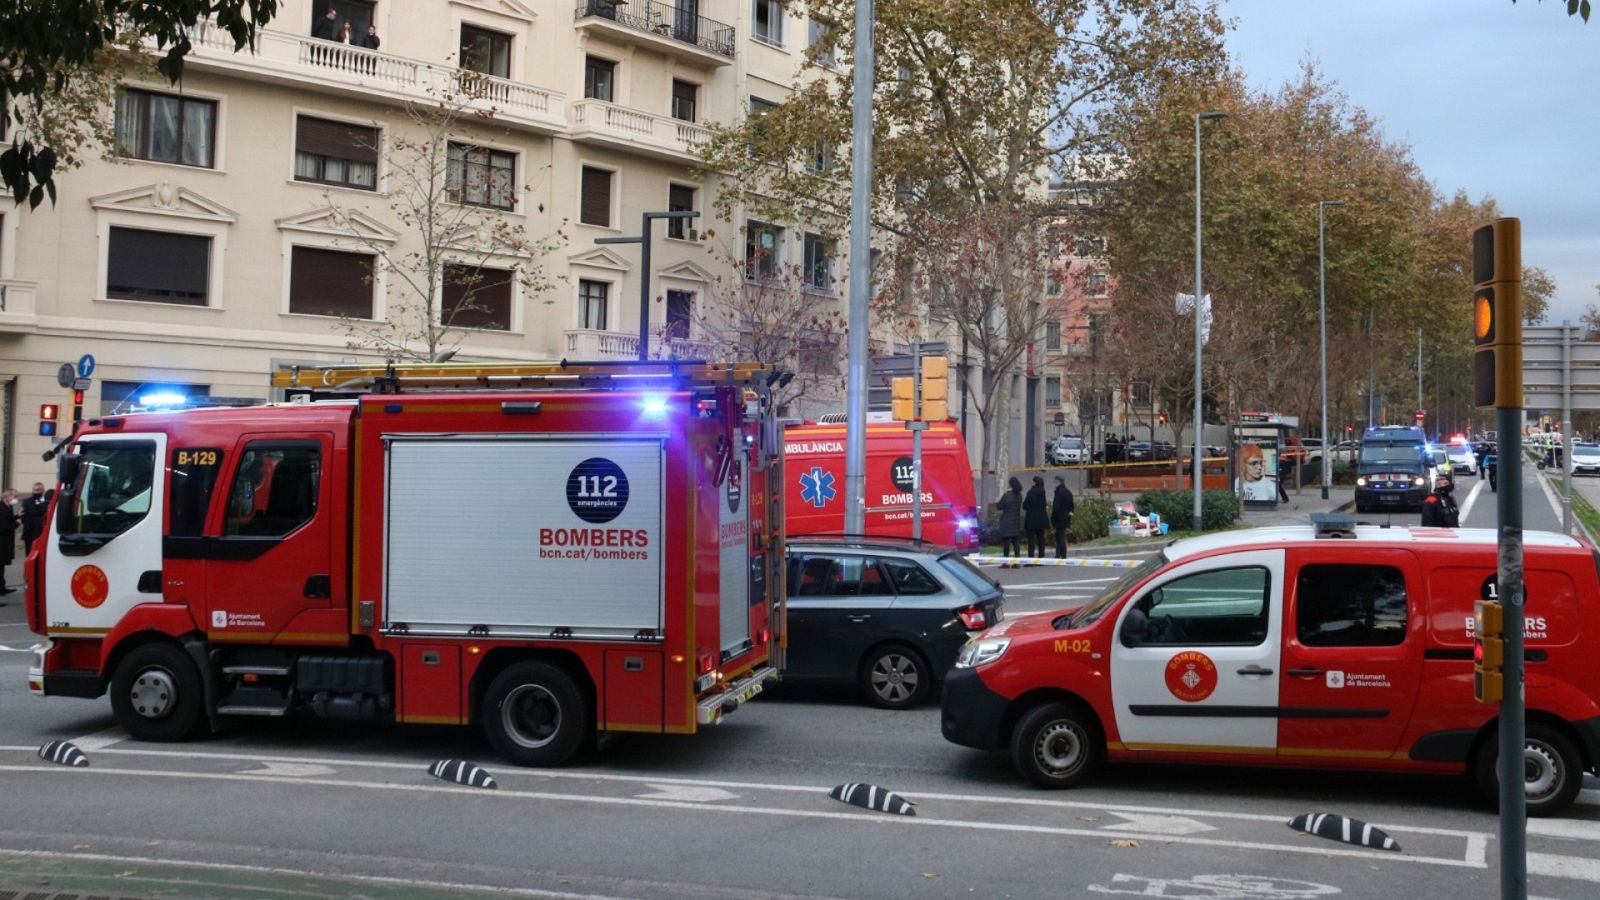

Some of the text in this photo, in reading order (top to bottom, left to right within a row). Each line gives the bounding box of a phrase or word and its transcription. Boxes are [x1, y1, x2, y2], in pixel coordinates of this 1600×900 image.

[785, 441, 843, 454] MBULÀNCIA
[178, 451, 216, 465] B-129
[577, 475, 618, 498] 112
[577, 499, 618, 508] emergències
[882, 493, 933, 505] BOMBRS
[884, 511, 936, 520] bcn.cat/bbers
[539, 528, 649, 547] BOMBERS
[539, 547, 649, 561] bcn.cat/bombers
[228, 613, 261, 621] Ajuntament
[1054, 639, 1091, 653] M-02
[1170, 653, 1214, 671] BOMBERS
[1346, 673, 1386, 681] Ajuntament
